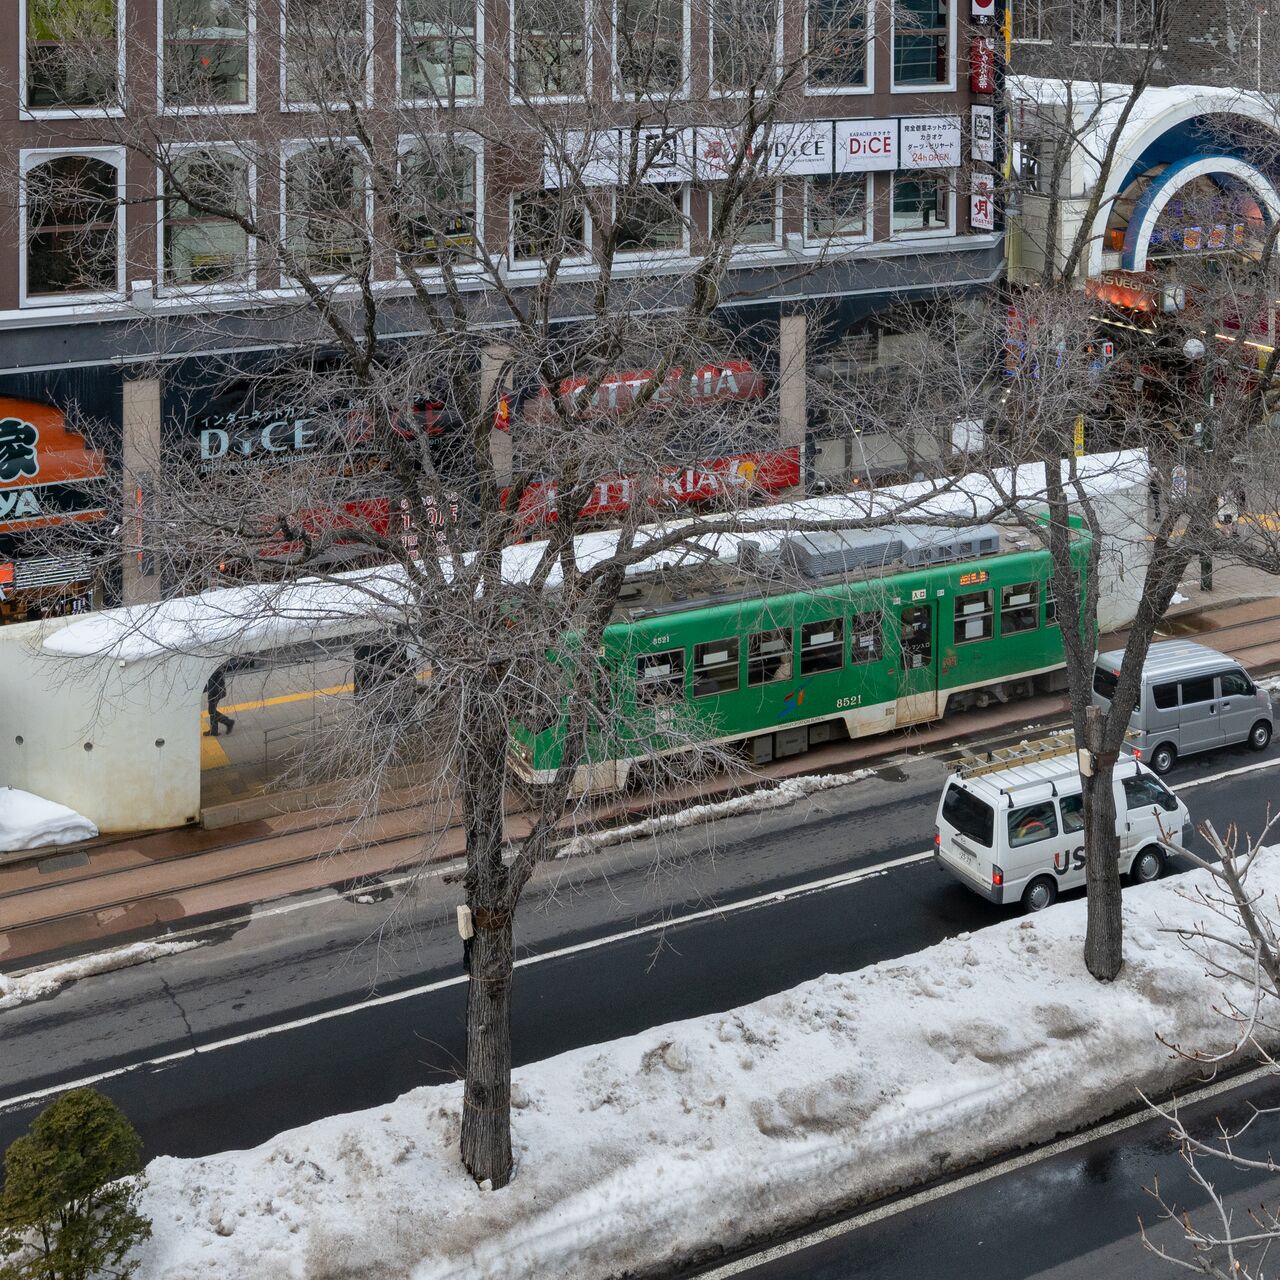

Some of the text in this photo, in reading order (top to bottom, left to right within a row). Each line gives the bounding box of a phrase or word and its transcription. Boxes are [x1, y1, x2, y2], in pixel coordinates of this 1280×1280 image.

[920, 133, 943, 141] カラオケ
[849, 137, 892, 155] DiCE
[836, 695, 862, 708] 8521
